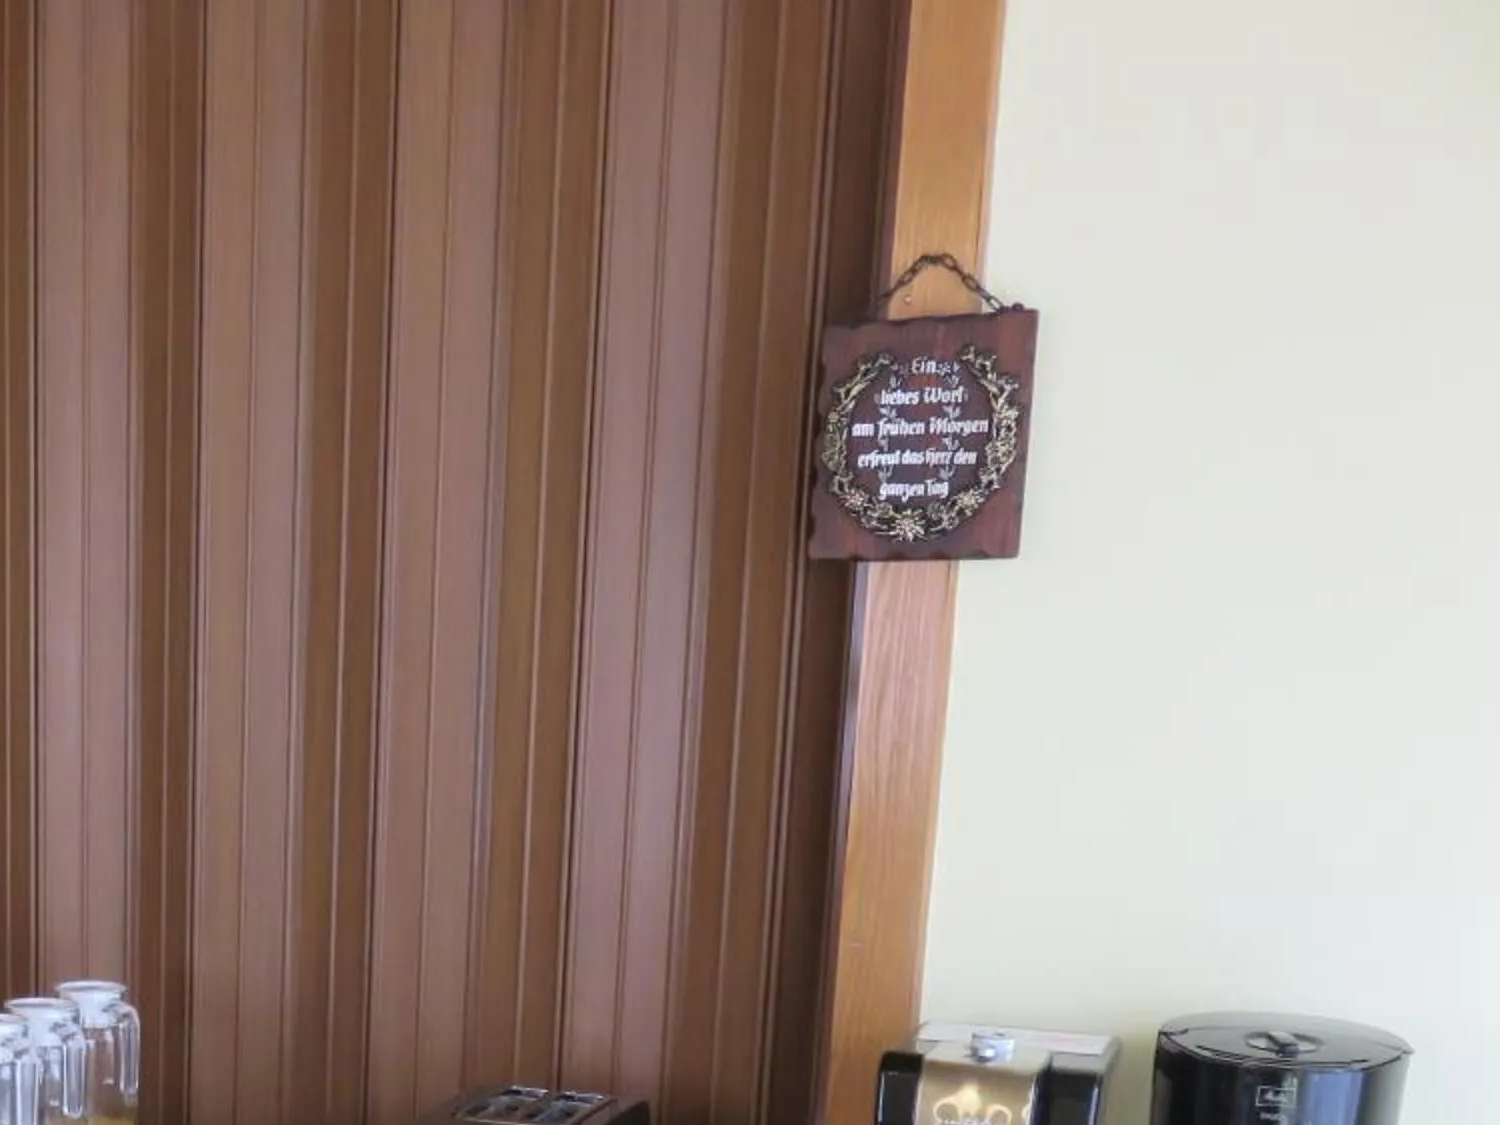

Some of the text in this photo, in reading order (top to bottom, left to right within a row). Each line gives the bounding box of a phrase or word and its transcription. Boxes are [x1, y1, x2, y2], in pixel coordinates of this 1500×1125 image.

[852, 422, 875, 437] am
[901, 449, 925, 465] das
[953, 448, 978, 465] den
[924, 478, 949, 499] Tag
